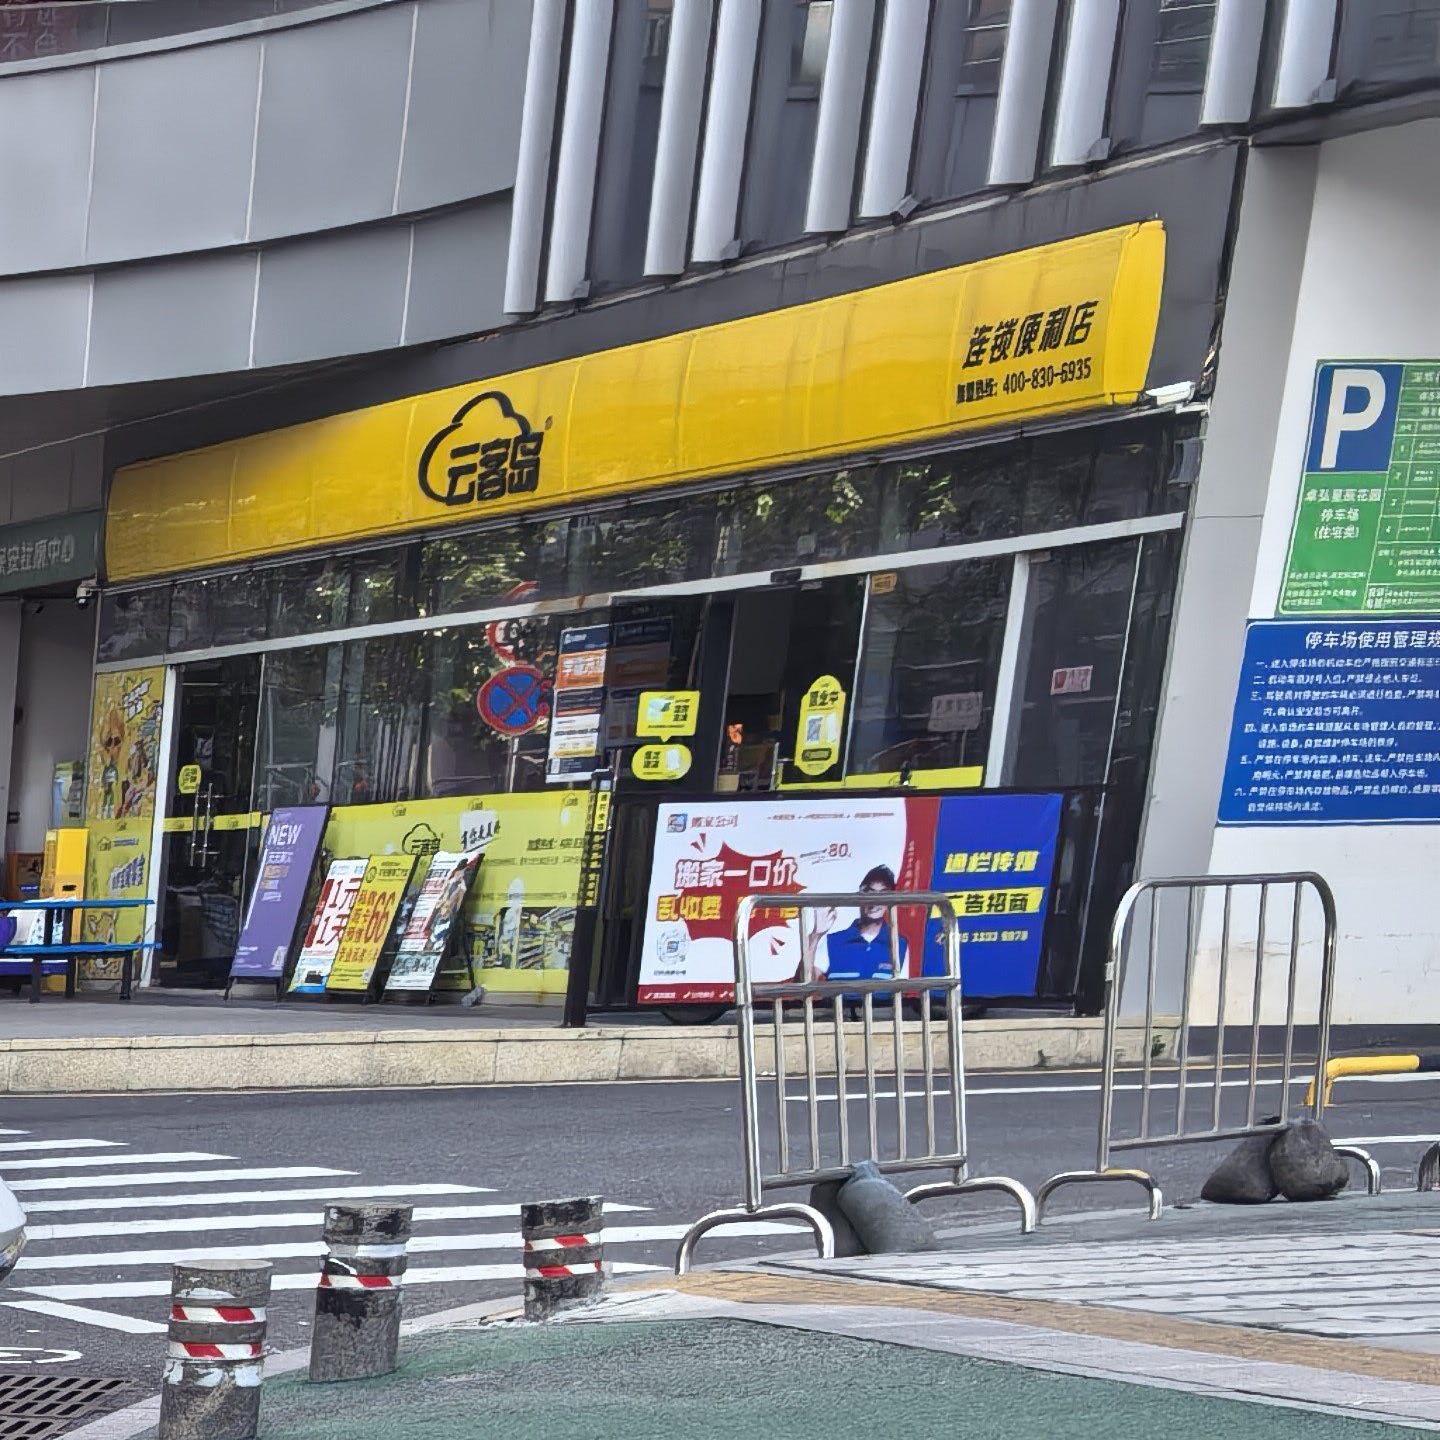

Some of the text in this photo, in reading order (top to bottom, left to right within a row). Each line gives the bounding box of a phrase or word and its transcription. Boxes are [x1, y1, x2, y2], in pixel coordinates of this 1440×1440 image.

[962, 299, 1099, 369] 连锁便利店
[1003, 356, 1092, 395] 400-830-6935
[1320, 369, 1386, 469] P
[445, 431, 545, 506] 云客岛
[1320, 507, 1360, 522] 停车场
[268, 823, 302, 846] NEW
[675, 858, 798, 889] 搬家一口价
[944, 851, 1040, 873] 通栏传媒
[657, 895, 722, 921] 乱收费
